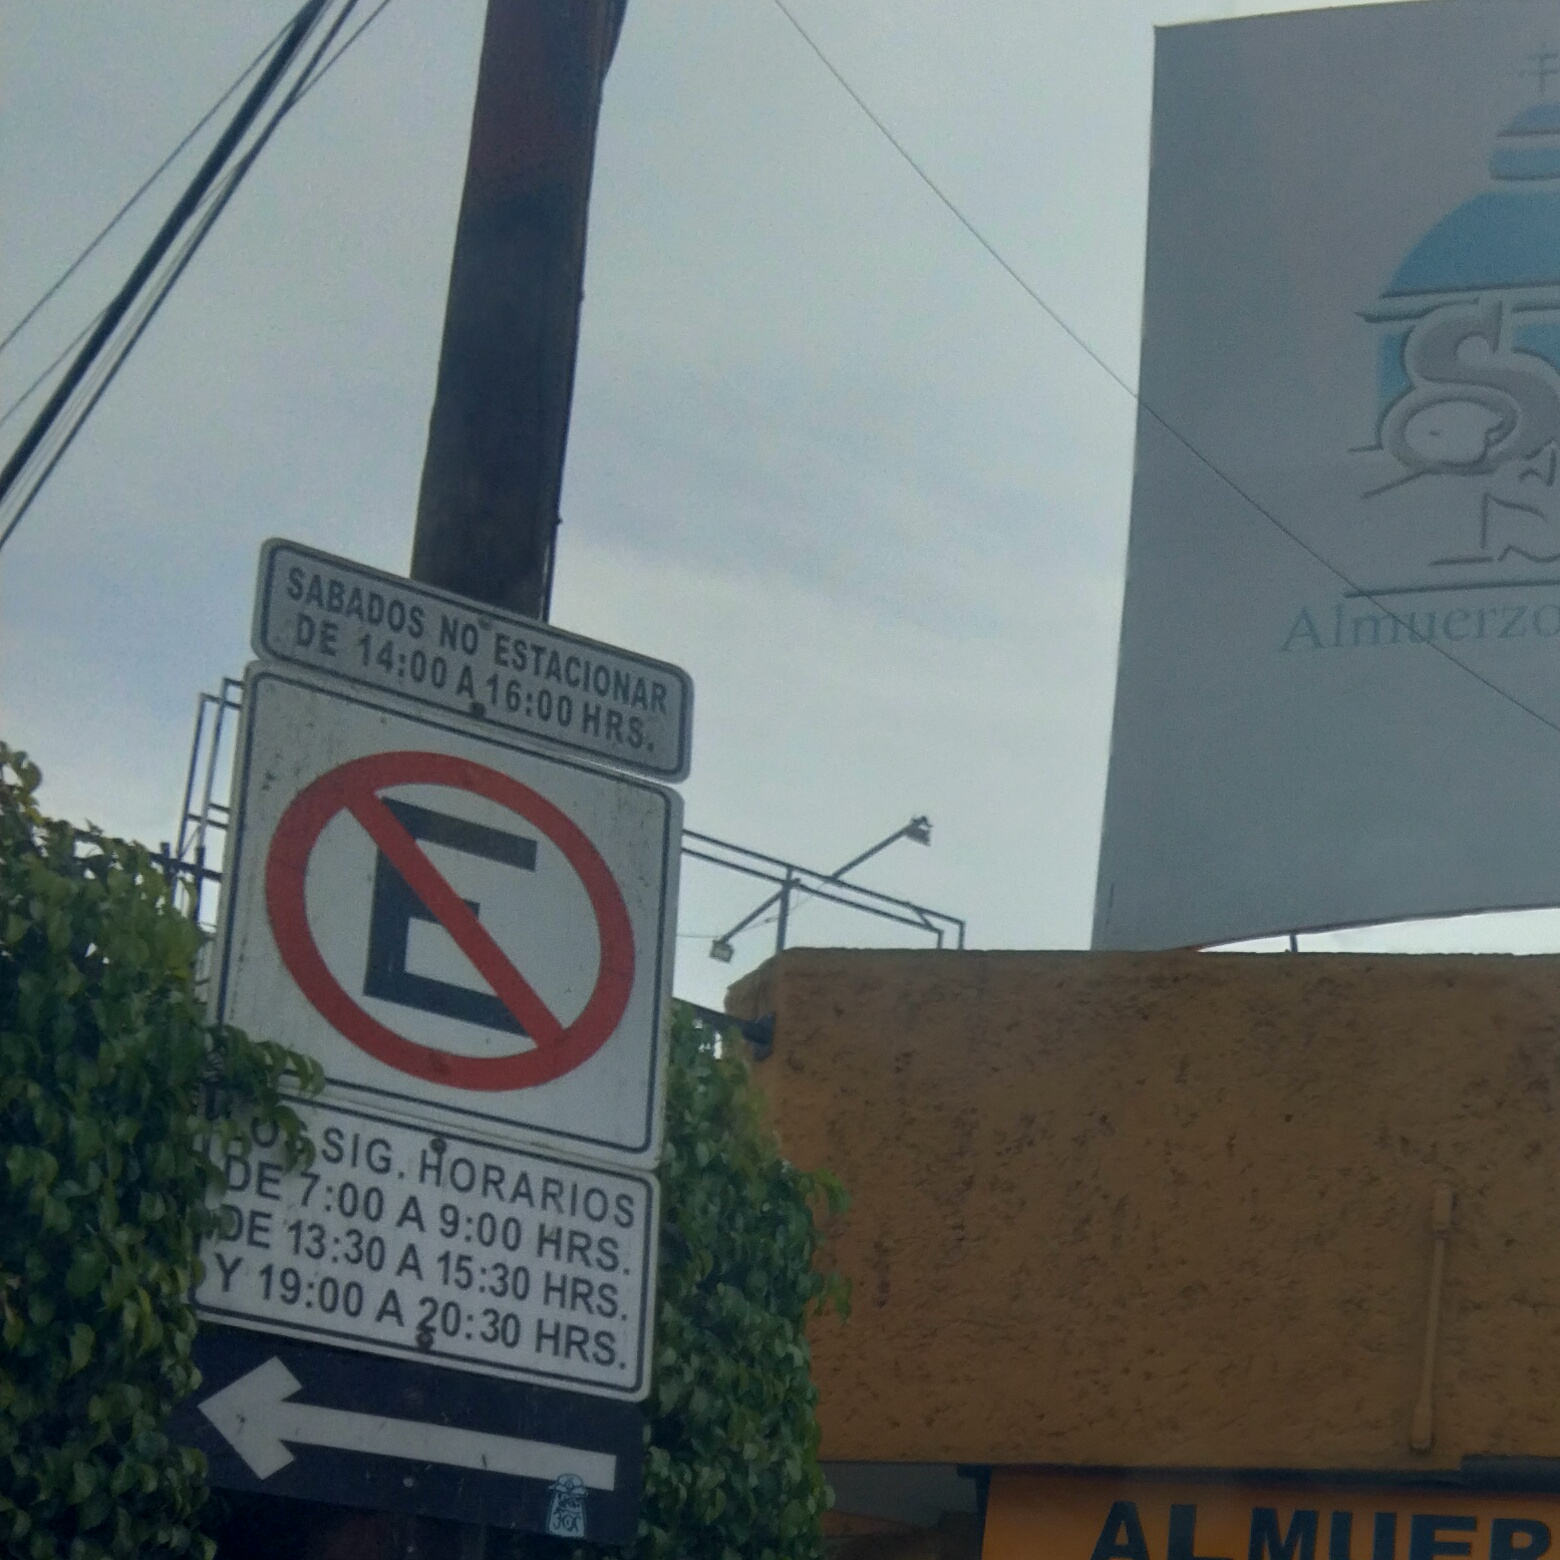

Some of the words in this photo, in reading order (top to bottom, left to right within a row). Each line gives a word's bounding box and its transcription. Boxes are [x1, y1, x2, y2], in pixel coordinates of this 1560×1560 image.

[286, 567, 426, 639] SABADOS
[439, 614, 480, 655] NO
[494, 632, 668, 714] ESTACIONAR
[297, 614, 340, 656] DE
[358, 633, 448, 689] 14:00
[456, 665, 475, 698] A
[486, 672, 573, 727] 16:00
[582, 700, 657, 753] HRS.
[225, 1155, 284, 1201] DE
[299, 1171, 385, 1223] 7:00
[397, 1196, 427, 1234] A
[438, 1204, 523, 1251] 9:00
[536, 1222, 631, 1276] HRS.
[321, 1126, 405, 1179] SIG.
[418, 1153, 636, 1230] HORARIOS
[214, 1252, 243, 1294] Y
[258, 1263, 364, 1318] 19:00
[375, 1289, 405, 1328] A
[417, 1295, 523, 1349] 20:30
[534, 1319, 628, 1370] HRS.
[218, 1203, 273, 1249] DE
[286, 1222, 386, 1272] 13:30
[395, 1244, 424, 1282] A
[437, 1250, 531, 1301] 15:30
[542, 1271, 629, 1322] HRS.
